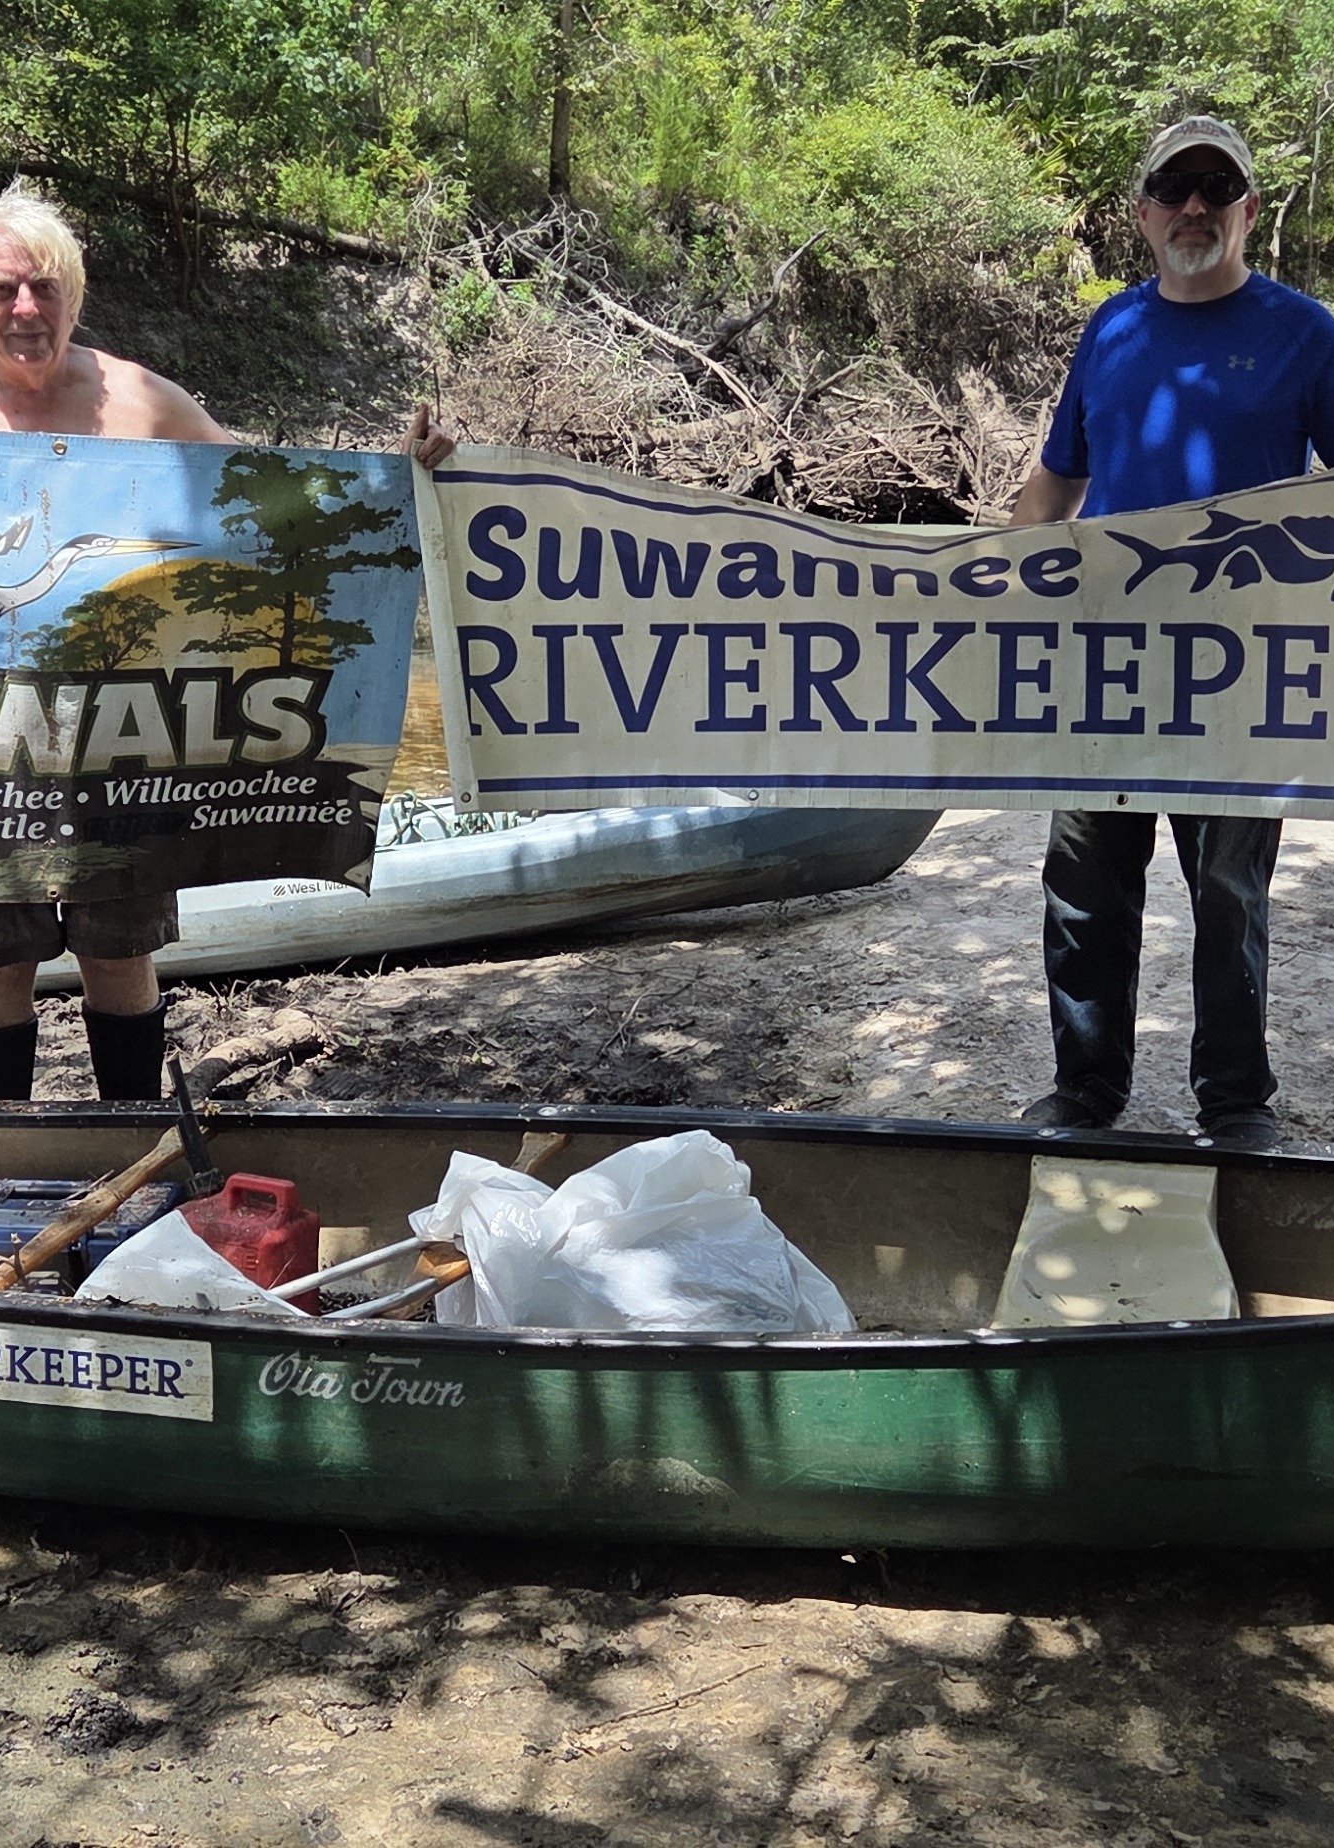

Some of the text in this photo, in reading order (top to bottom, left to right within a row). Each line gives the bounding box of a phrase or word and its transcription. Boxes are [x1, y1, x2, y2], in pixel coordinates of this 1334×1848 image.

[466, 505, 1083, 601] Suwannee
[103, 769, 318, 806] Willacoochee
[189, 803, 353, 831] Suwannee
[287, 881, 322, 895] West
[351, 1352, 467, 1408] Town
